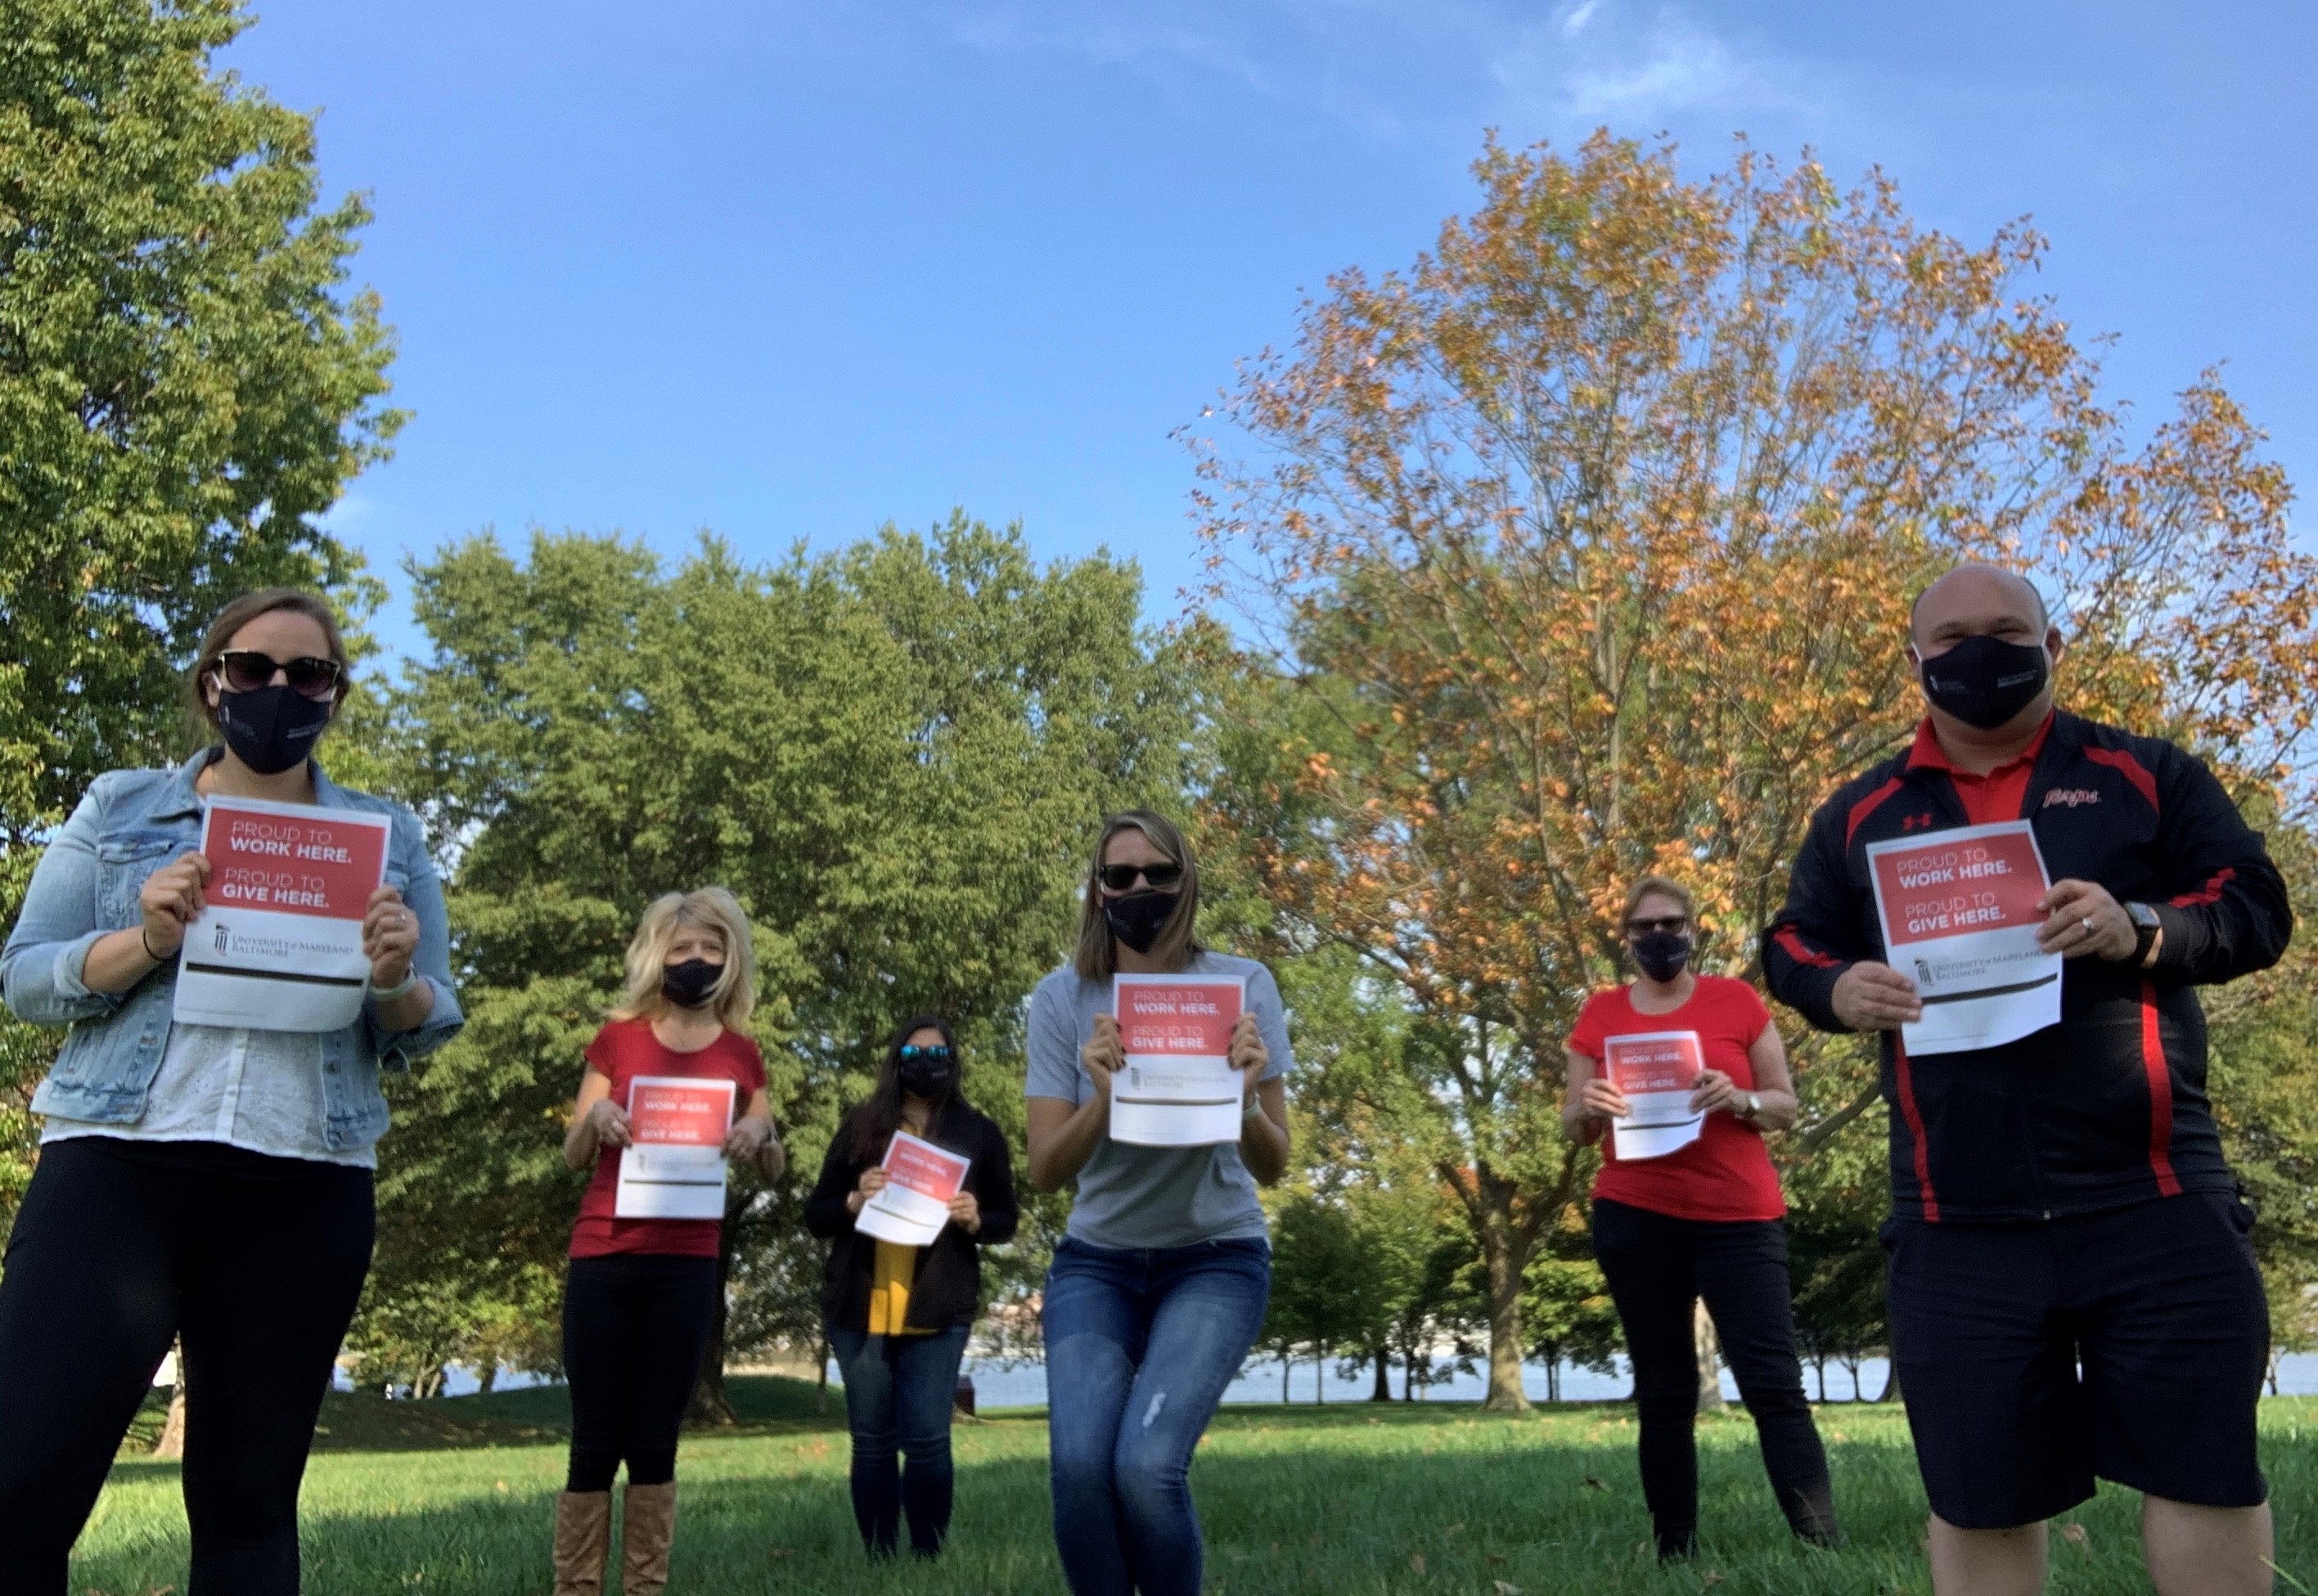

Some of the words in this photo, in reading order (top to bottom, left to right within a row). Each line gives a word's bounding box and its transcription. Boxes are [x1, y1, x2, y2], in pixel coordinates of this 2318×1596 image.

[232, 820, 300, 841] PROUD
[308, 829, 331, 844] TO
[231, 837, 290, 856] WORK
[297, 843, 352, 863] HERE.
[1897, 852, 1957, 874] PROUD
[1963, 847, 1987, 861] TO
[225, 868, 294, 888] PROUD
[301, 875, 325, 891] TO
[1899, 870, 1954, 888] WORK
[1960, 860, 2012, 879] HERE.
[223, 884, 268, 901] GIVE
[274, 888, 330, 907] HERE.
[1905, 896, 1965, 919] PROUD
[1971, 891, 1995, 906] TO
[1907, 915, 1949, 933] GIVE
[1955, 906, 2005, 926] HERE.
[1134, 991, 1182, 1002] PROUD
[1186, 991, 1204, 1002] TO
[1133, 1003, 1177, 1014] WORK
[1180, 1003, 1220, 1015] HERE.
[1132, 1025, 1182, 1036] PROUD
[1186, 1026, 1204, 1036] TO
[1132, 1037, 1165, 1048] GIVE
[1168, 1037, 1209, 1049] HERE.
